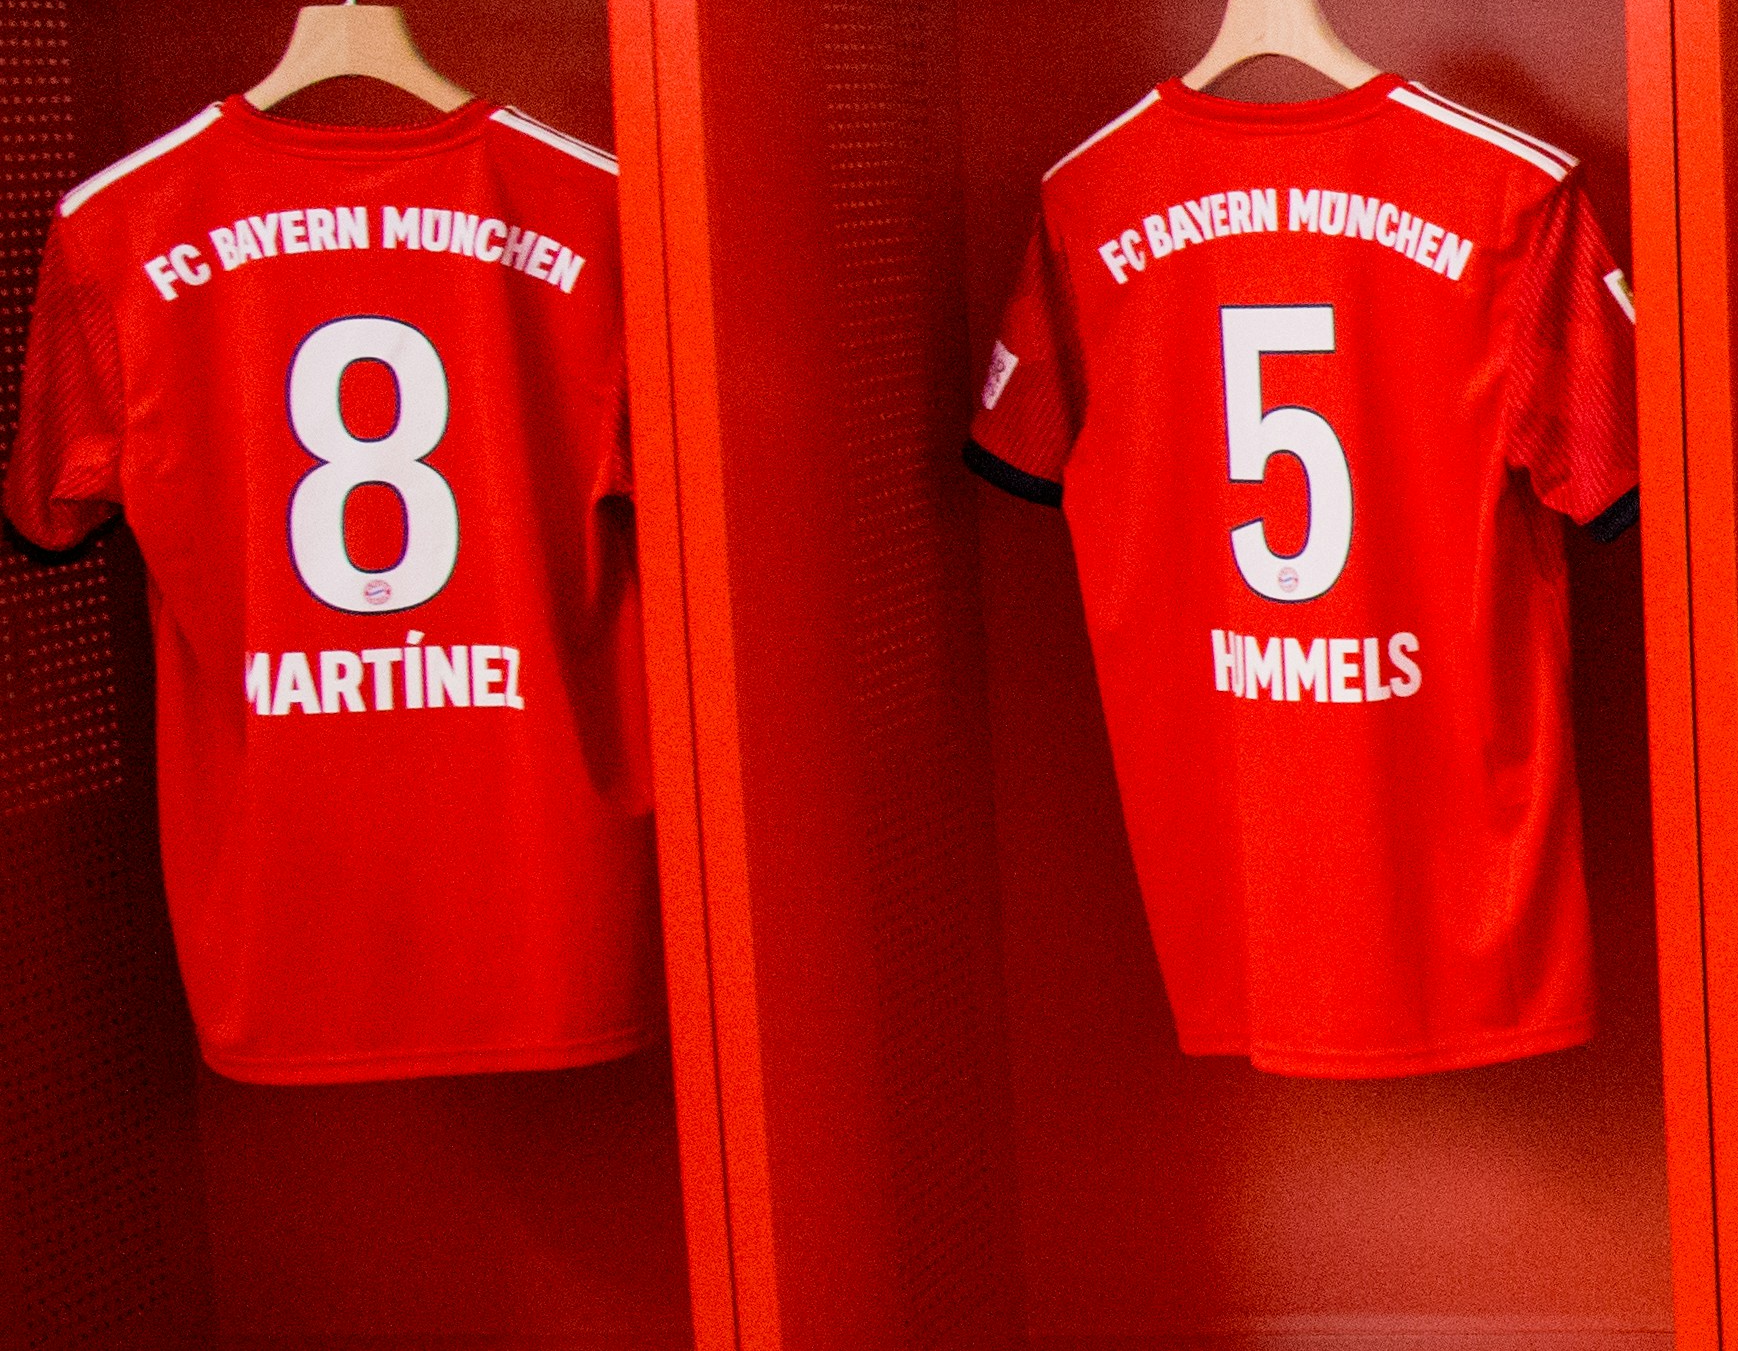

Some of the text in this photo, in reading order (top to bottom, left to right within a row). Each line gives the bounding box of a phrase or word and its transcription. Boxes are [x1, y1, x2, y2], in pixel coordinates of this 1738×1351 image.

[145, 244, 210, 300] FC
[210, 206, 368, 270] BAYERN
[1099, 230, 1145, 284] FC
[1143, 188, 1277, 258] BAYERN
[288, 316, 460, 614] 8
[1220, 305, 1354, 602] 5
